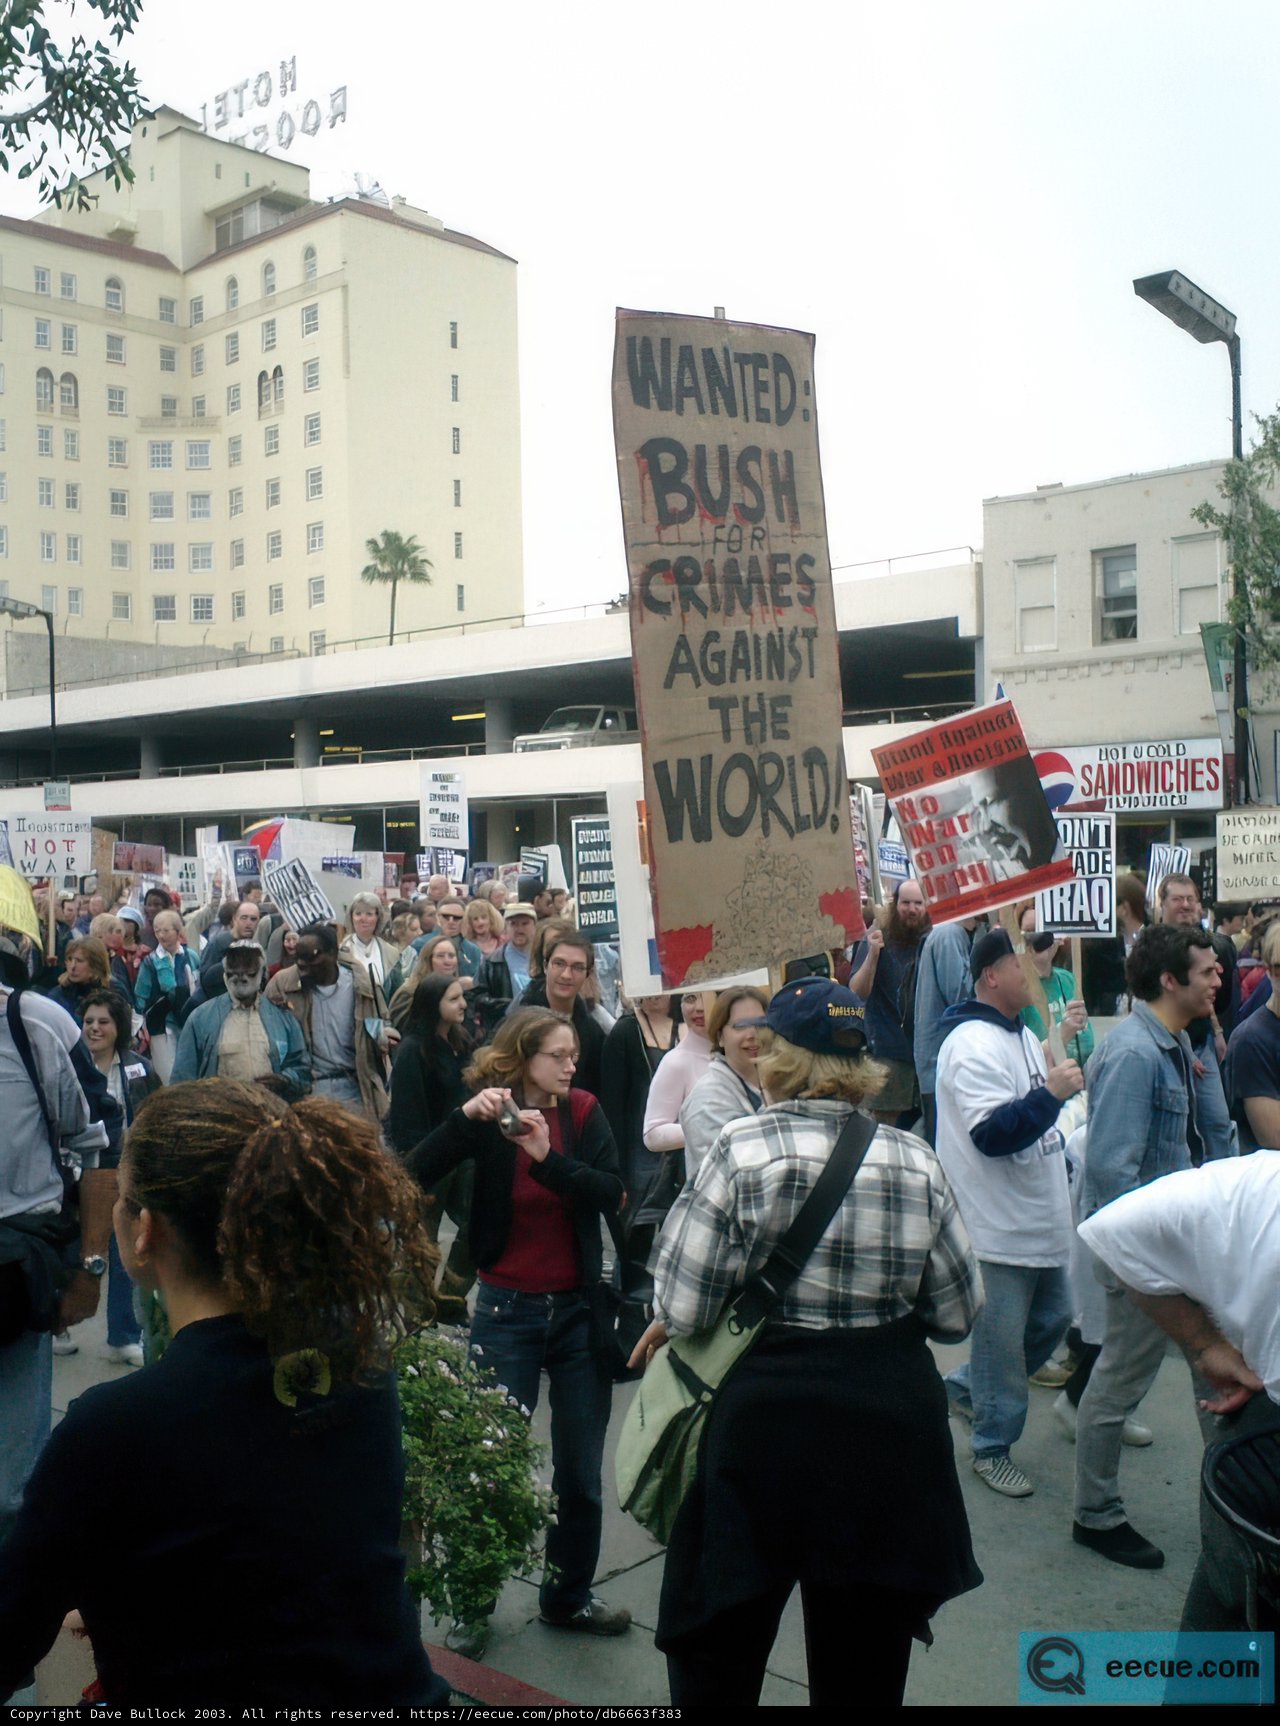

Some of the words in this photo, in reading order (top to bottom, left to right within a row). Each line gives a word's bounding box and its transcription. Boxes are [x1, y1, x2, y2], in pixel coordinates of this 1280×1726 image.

[626, 335, 810, 426] WANTED:
[637, 437, 800, 526] BUSH
[713, 524, 766, 554] FOR
[642, 553, 816, 619] CRIMES
[663, 626, 818, 689] AGAINST
[708, 692, 793, 745] THE
[653, 746, 844, 843] WORLD!
[1081, 757, 1220, 798] SANDWICHES
[24, 838, 76, 857] NOT
[1056, 818, 1111, 848] ON'T
[1042, 879, 1111, 932] IRAQ
